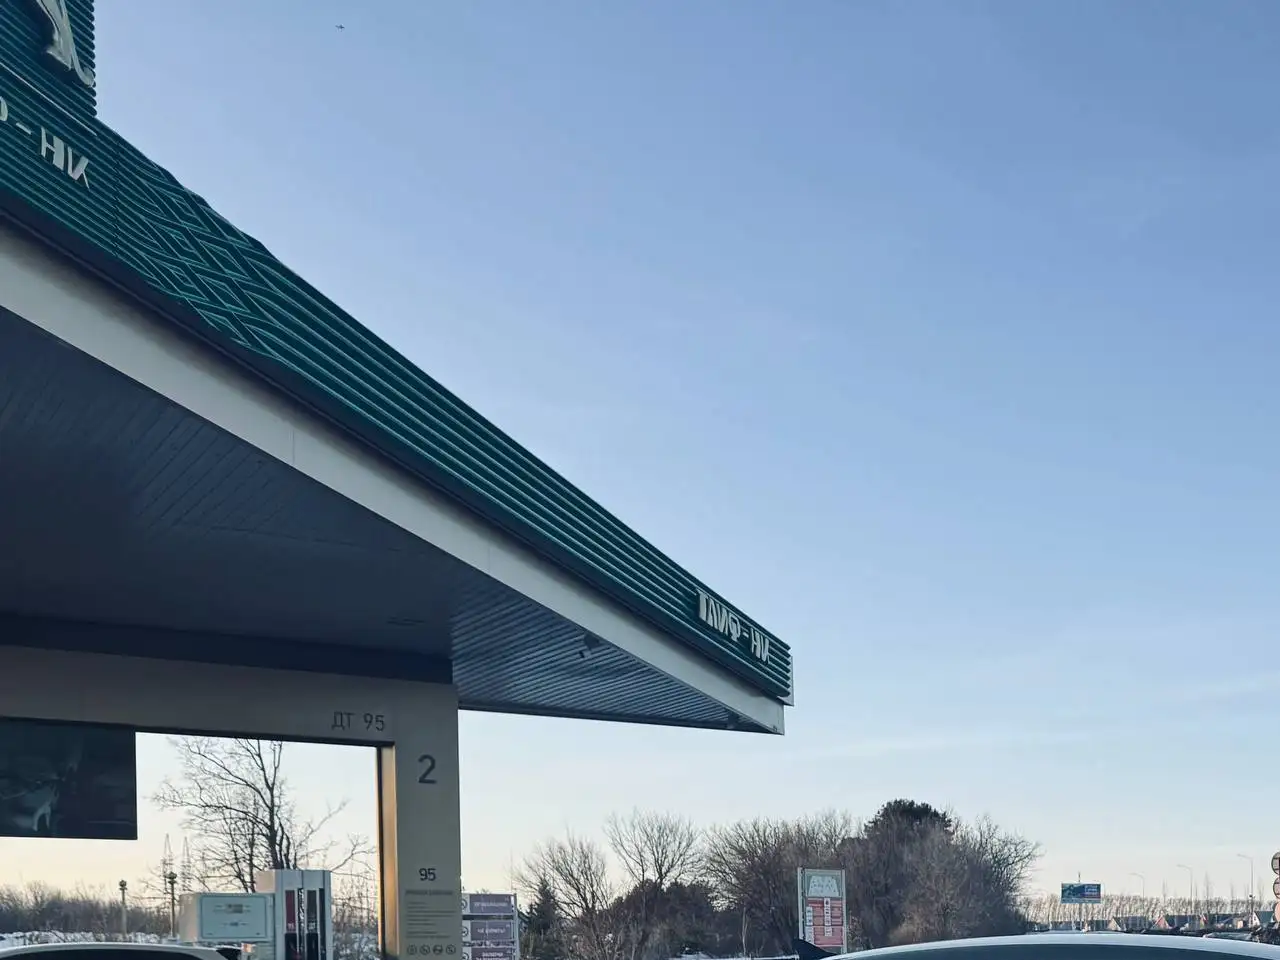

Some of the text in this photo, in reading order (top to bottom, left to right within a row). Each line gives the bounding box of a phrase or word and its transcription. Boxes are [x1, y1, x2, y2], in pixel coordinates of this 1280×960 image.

[331, 711, 386, 732] ДТ 95
[418, 754, 438, 785] 2
[419, 867, 437, 882] 95
